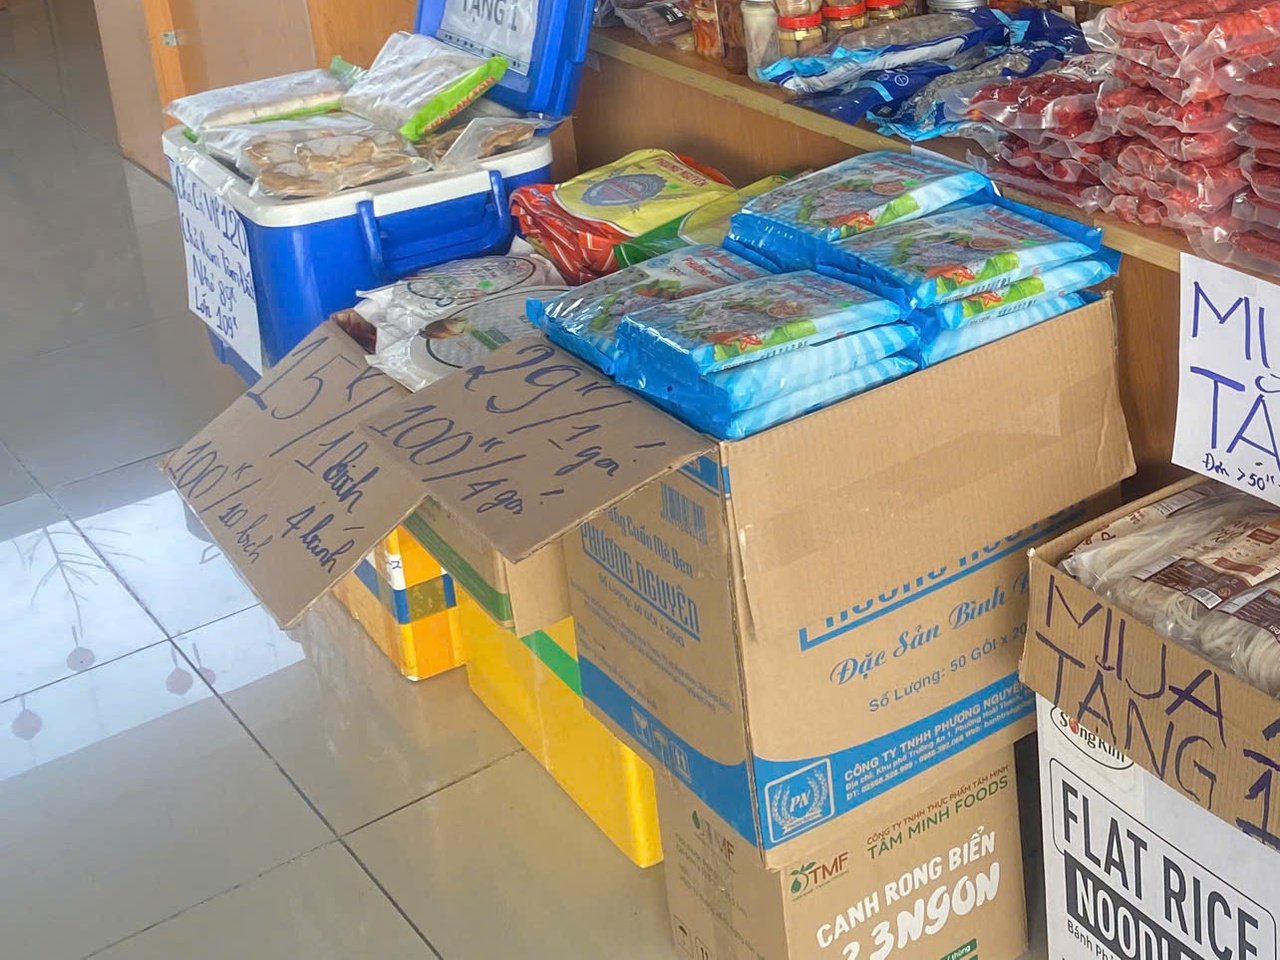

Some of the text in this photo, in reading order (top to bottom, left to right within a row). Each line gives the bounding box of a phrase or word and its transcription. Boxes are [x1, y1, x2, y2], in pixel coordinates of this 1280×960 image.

[948, 585, 1007, 631] Bình
[868, 691, 891, 714] Số
[949, 653, 967, 674] 50
[970, 636, 998, 662] GÓI
[1046, 574, 1227, 749] MUA
[844, 755, 880, 782] CÔNG
[881, 748, 898, 764] TY
[900, 730, 933, 754] TNHH
[934, 703, 982, 739] PHƯƠNG
[1035, 630, 1218, 811] TẶNG
[866, 774, 1010, 860] TÂM MINH FOODS
[808, 851, 850, 886] TMF
[815, 891, 879, 948] CANH
[884, 855, 943, 906] RONG
[948, 825, 997, 872] BIỂN
[1061, 777, 1260, 960] FLAT RICE
[1066, 918, 1094, 952] Bánh
